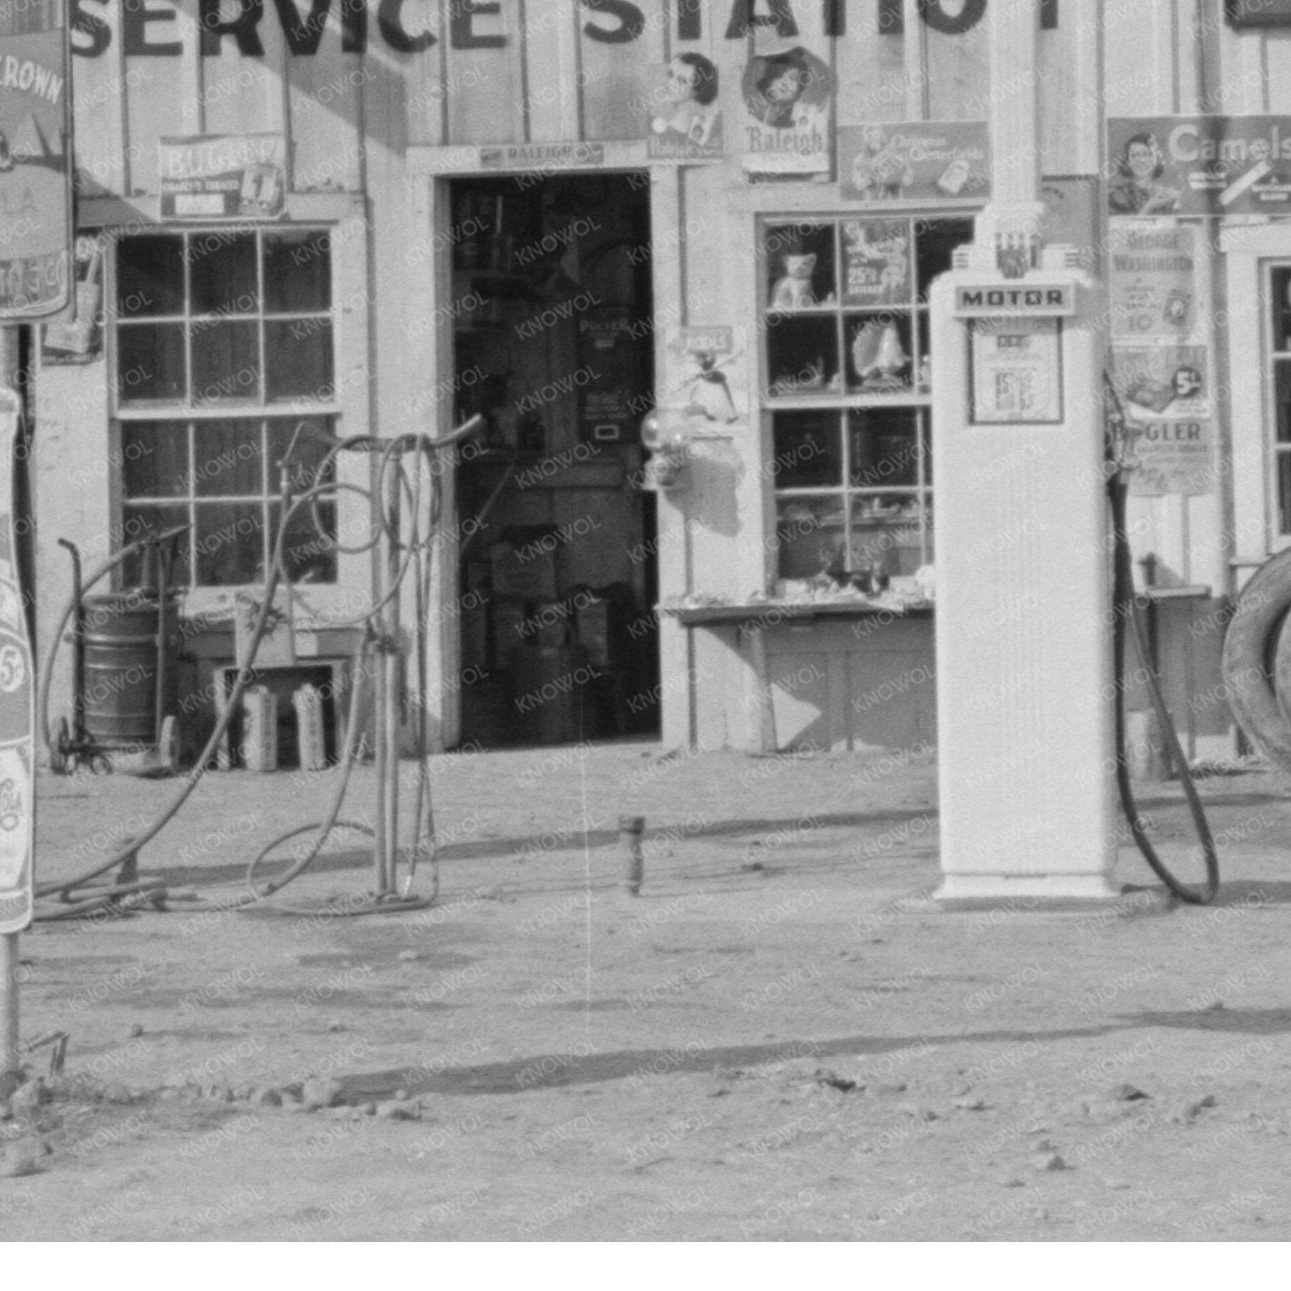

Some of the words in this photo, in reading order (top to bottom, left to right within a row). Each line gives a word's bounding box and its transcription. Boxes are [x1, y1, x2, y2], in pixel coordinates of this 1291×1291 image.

[745, 126, 824, 154] Raleigh
[508, 146, 573, 162] RALEIGH
[1127, 232, 1180, 250] GEORGE
[961, 288, 1064, 307] MOTOR
